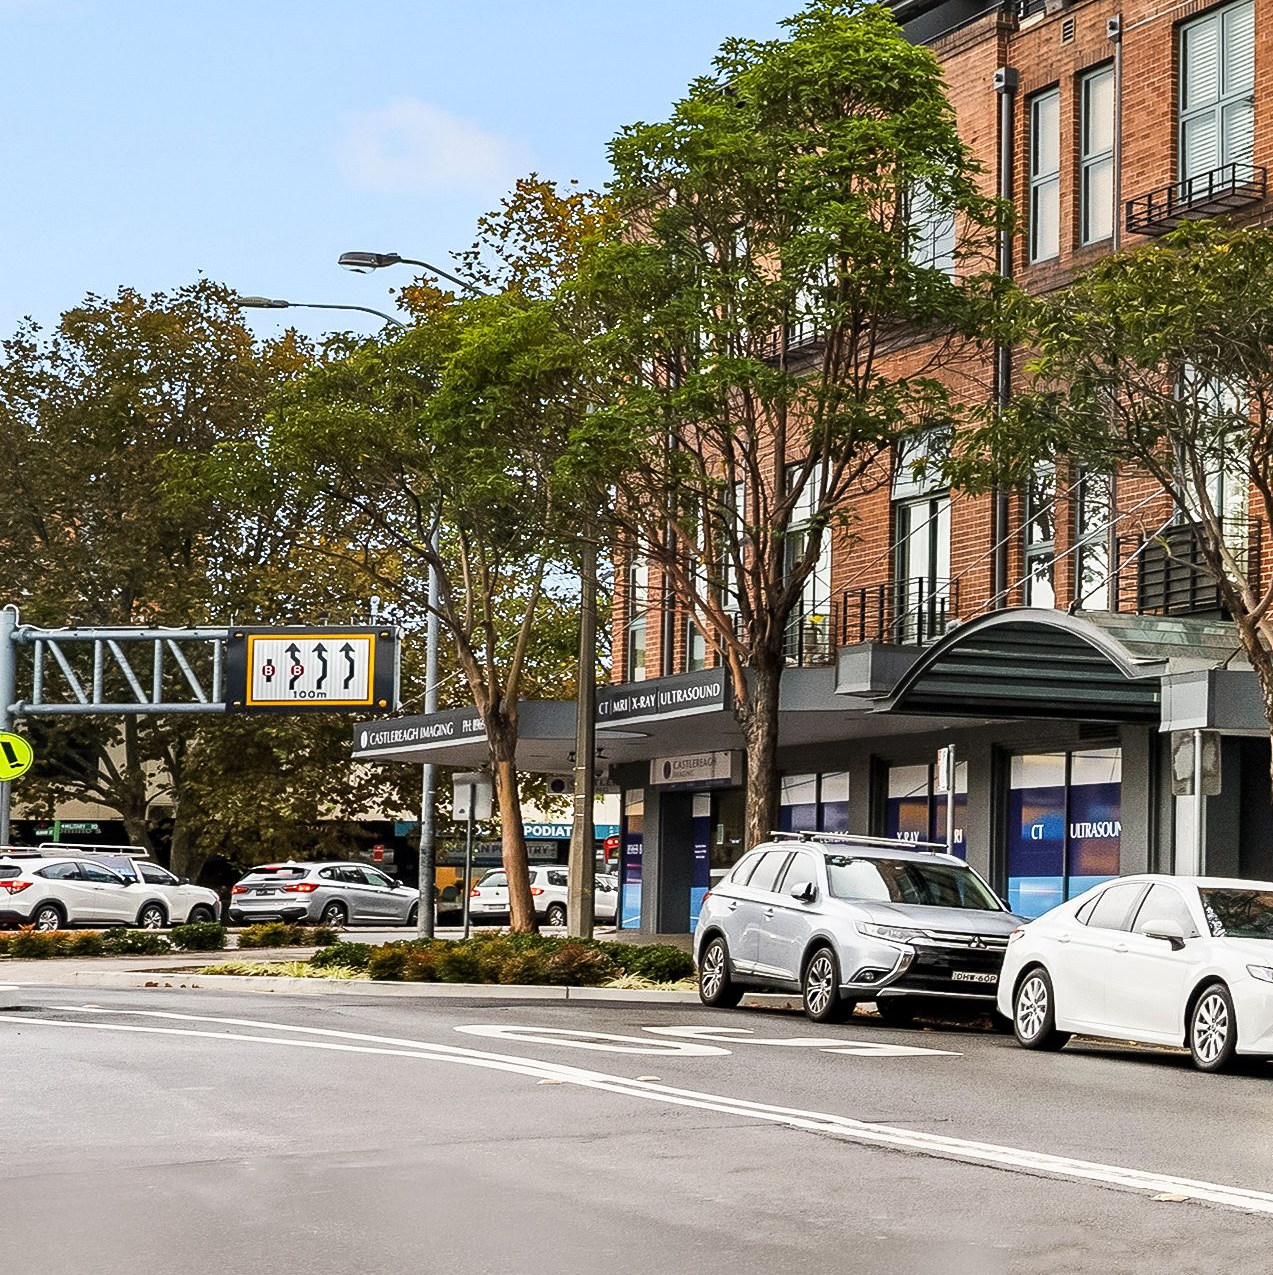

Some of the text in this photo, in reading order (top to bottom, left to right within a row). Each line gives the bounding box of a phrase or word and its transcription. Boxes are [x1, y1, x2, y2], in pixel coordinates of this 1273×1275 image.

[293, 690, 327, 699] 100m
[598, 683, 720, 715] CT MRI X-RAY ULTRASOUND
[369, 727, 419, 745] CASTLEREAGH
[420, 722, 454, 739] IMAGING
[524, 825, 573, 837] PODIAT
[1031, 824, 1044, 840] CT
[1070, 821, 1122, 839] ULTRASOUN
